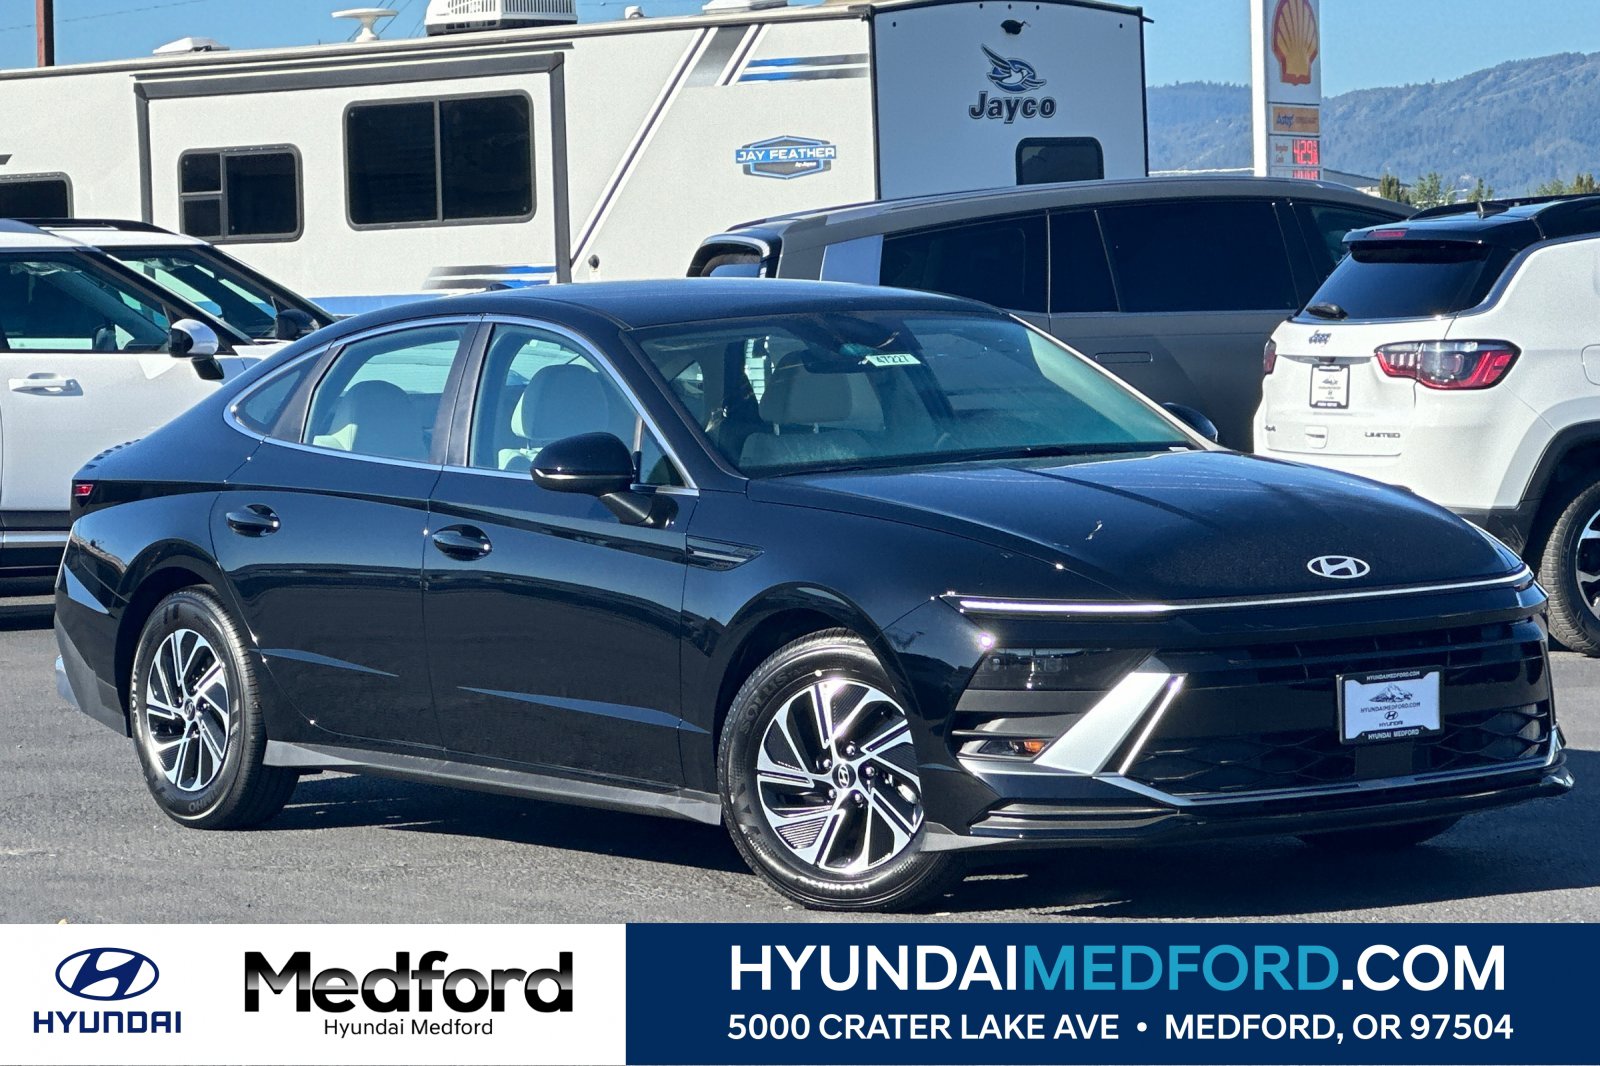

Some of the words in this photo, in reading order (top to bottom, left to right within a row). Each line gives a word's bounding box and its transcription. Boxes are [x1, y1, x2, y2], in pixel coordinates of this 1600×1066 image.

[969, 91, 1057, 124] Jayco
[737, 150, 765, 161] JAY
[769, 147, 835, 160] FEATHER
[1364, 431, 1401, 439] LIMITED
[1360, 702, 1421, 713] HYUNDAIMEDFORD.COM
[1379, 720, 1404, 728] HYUNDAI
[1368, 731, 1392, 740] HYUNDAI
[1393, 729, 1420, 738] MEDFORD
